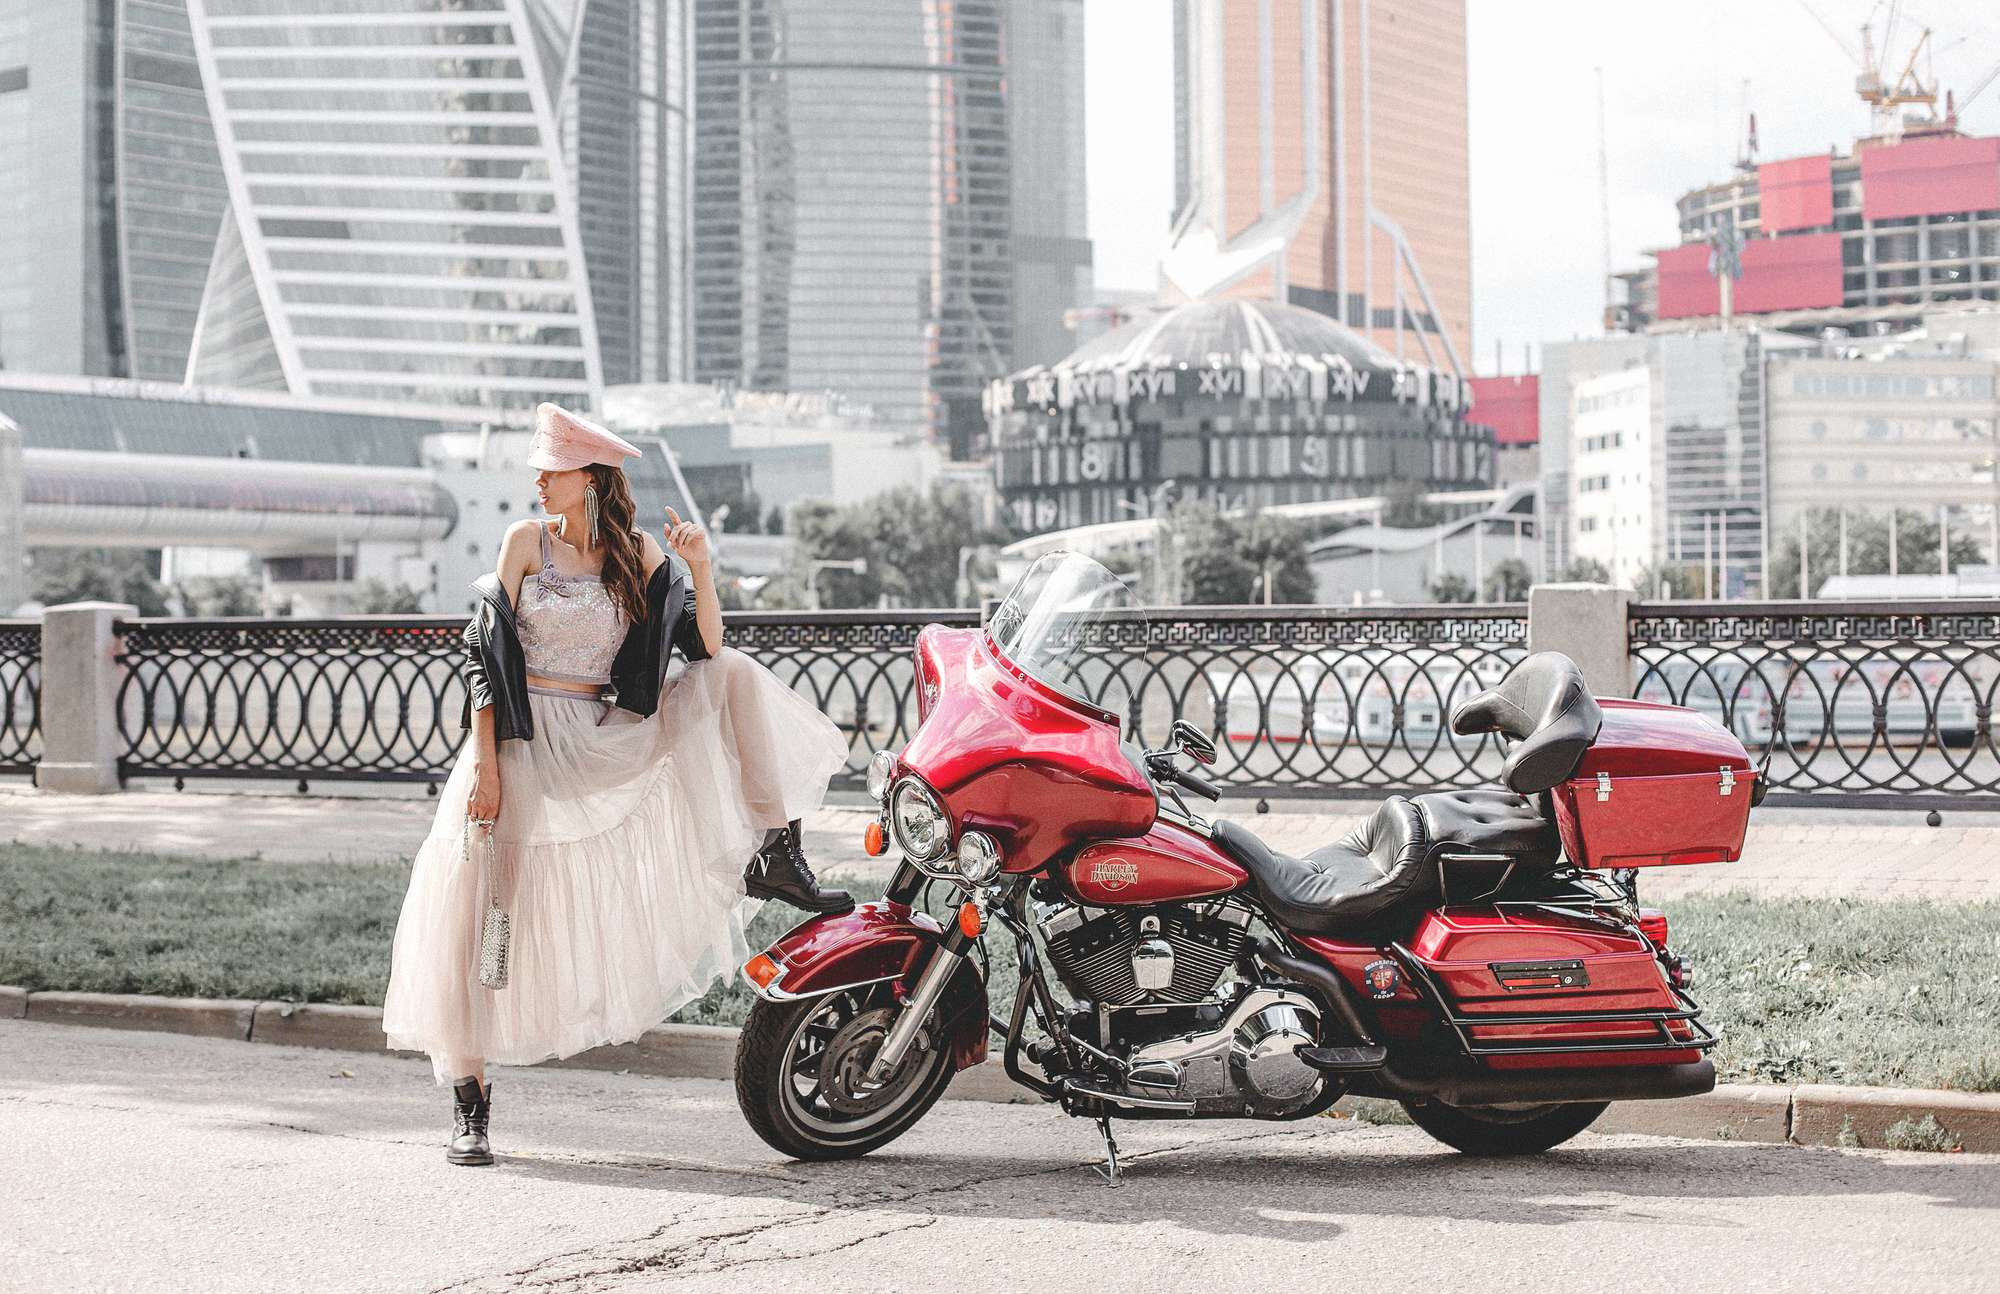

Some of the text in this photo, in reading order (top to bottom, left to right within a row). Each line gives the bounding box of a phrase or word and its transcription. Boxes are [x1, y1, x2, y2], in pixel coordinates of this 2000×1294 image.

[1198, 369, 1242, 396] XVI
[1093, 863, 1138, 873] HARLEY
[1090, 871, 1139, 885] DAVIDSON
